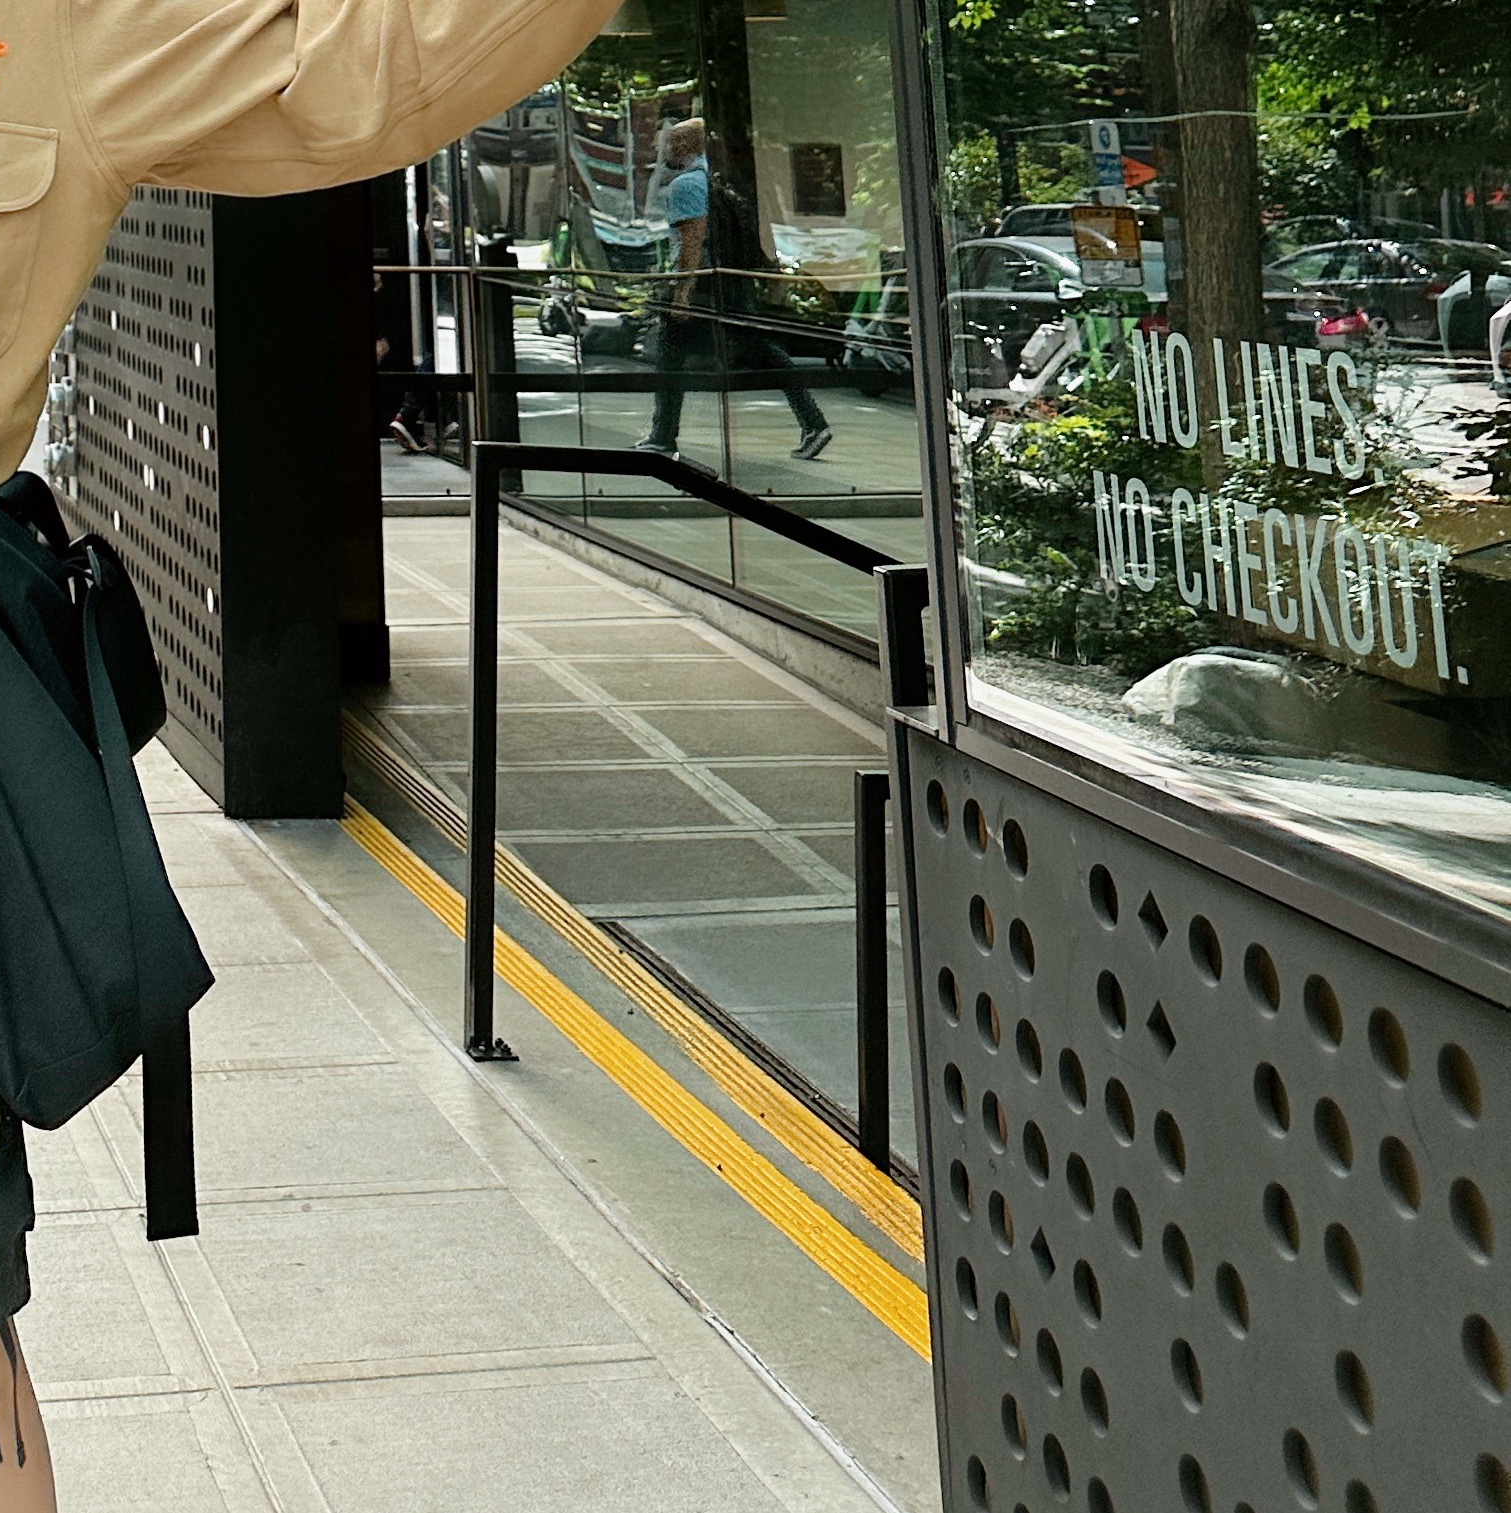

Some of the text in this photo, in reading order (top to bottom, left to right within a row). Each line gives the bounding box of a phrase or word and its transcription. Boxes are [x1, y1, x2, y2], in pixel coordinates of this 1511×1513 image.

[1131, 328, 1200, 449] NO
[1092, 469, 1469, 686] NO CHECKOUT.
